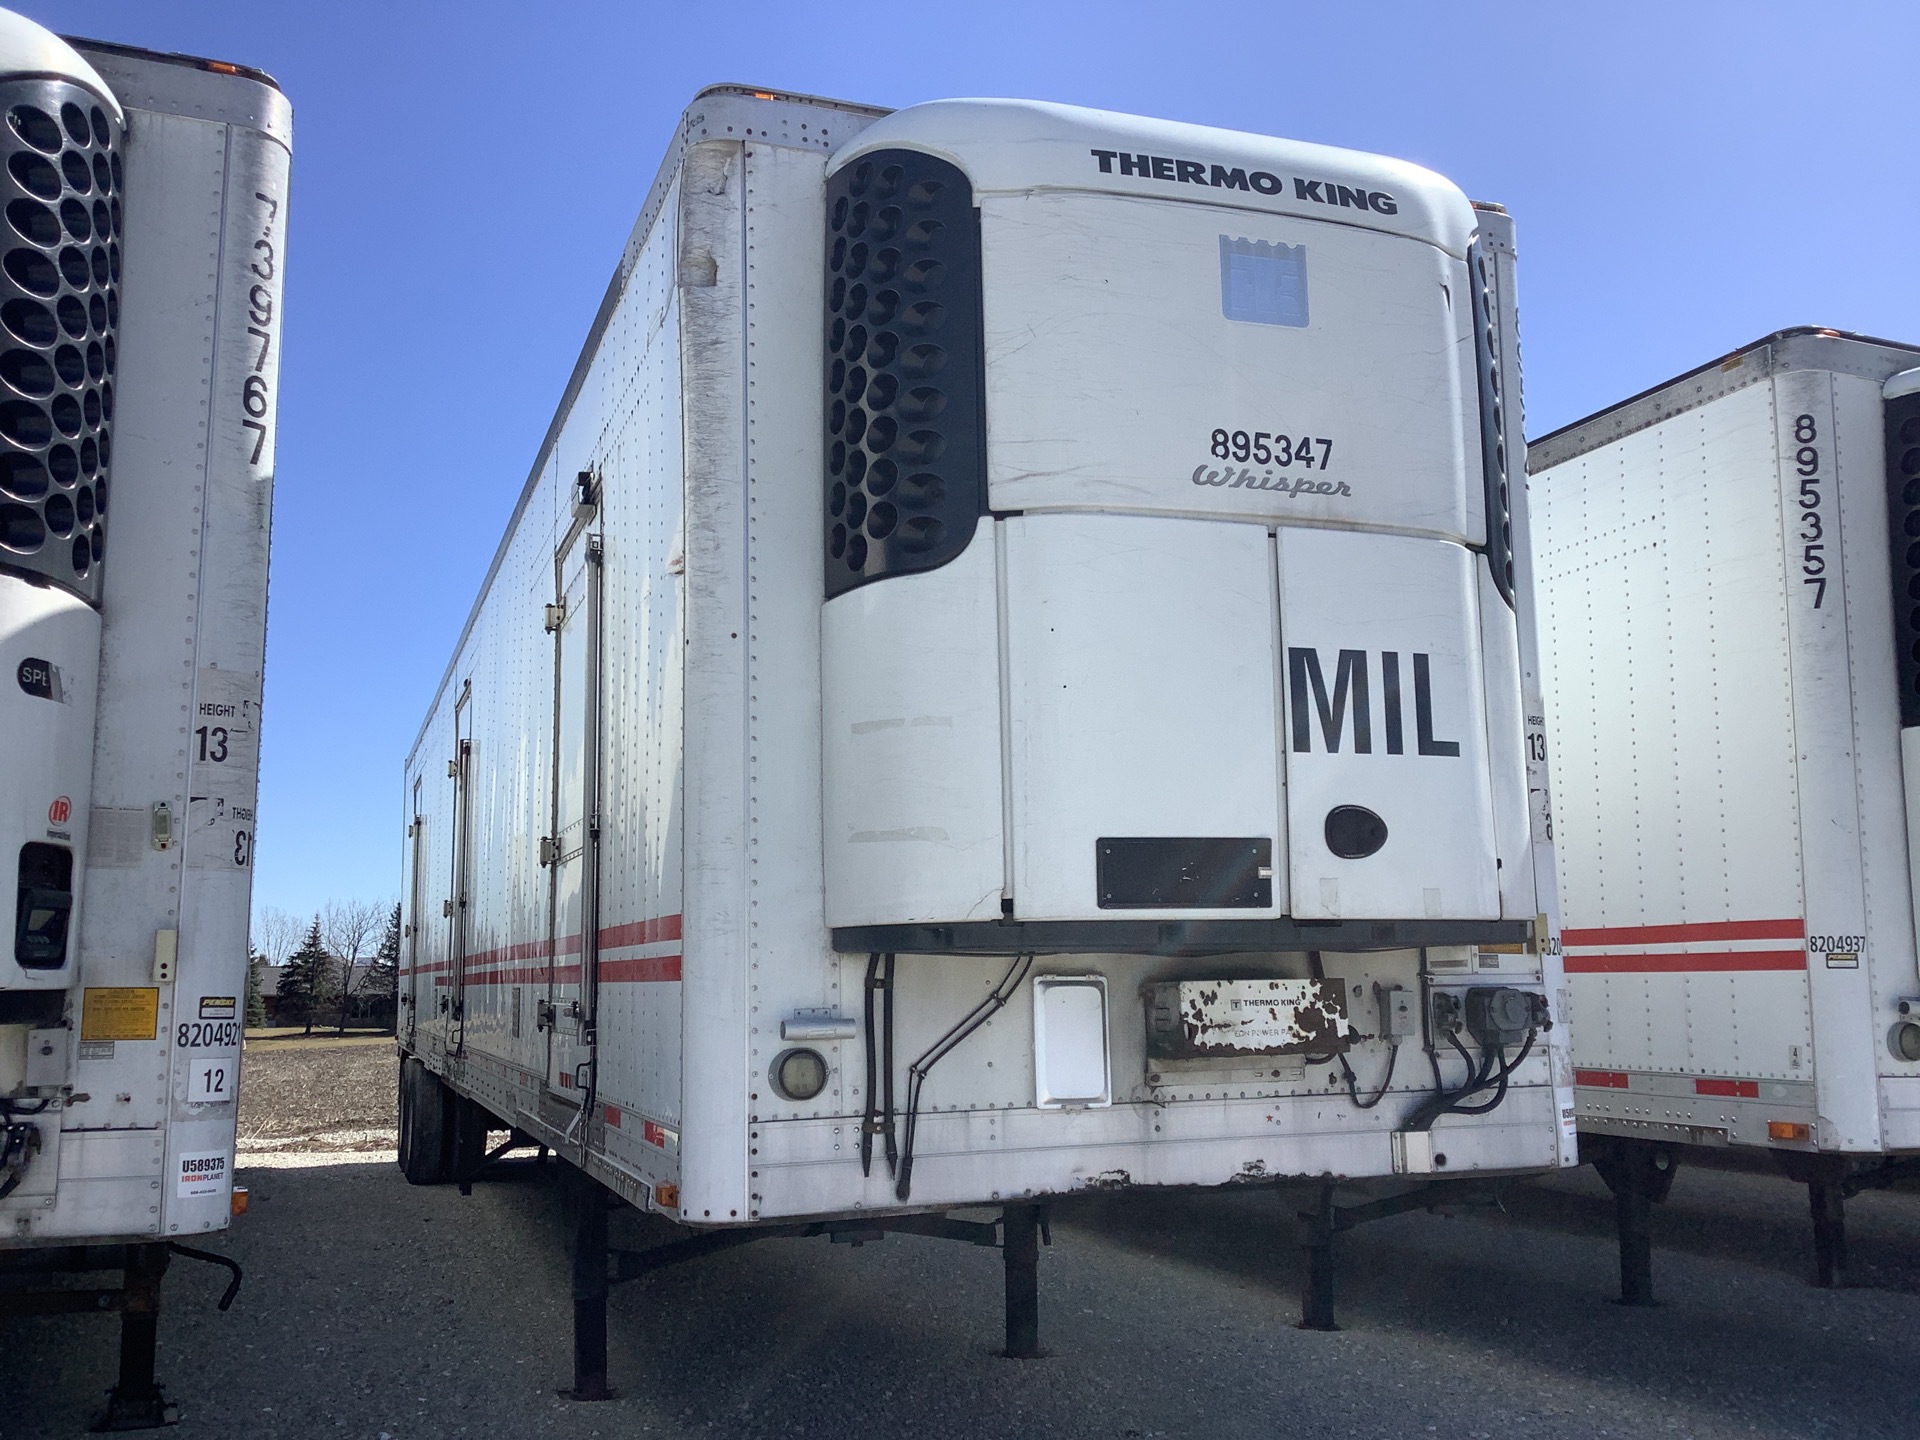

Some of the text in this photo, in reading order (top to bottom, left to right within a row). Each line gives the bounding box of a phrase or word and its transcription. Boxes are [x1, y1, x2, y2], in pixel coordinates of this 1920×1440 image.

[1090, 148, 1398, 216] THERMO KING
[1210, 428, 1333, 471] 895347
[1191, 463, 1352, 499] Whisper
[1794, 413, 1827, 610] 895357
[199, 703, 236, 718] HEIGHT
[1287, 646, 1461, 758] MIL
[195, 725, 229, 763] 13
[1527, 732, 1546, 762] 13
[52, 800, 70, 823] IR
[1809, 935, 1866, 953] 8204937
[1243, 1000, 1280, 1008] THERMO
[1281, 999, 1301, 1007] KING
[203, 1068, 225, 1094] 12
[182, 1156, 225, 1173] U589375
